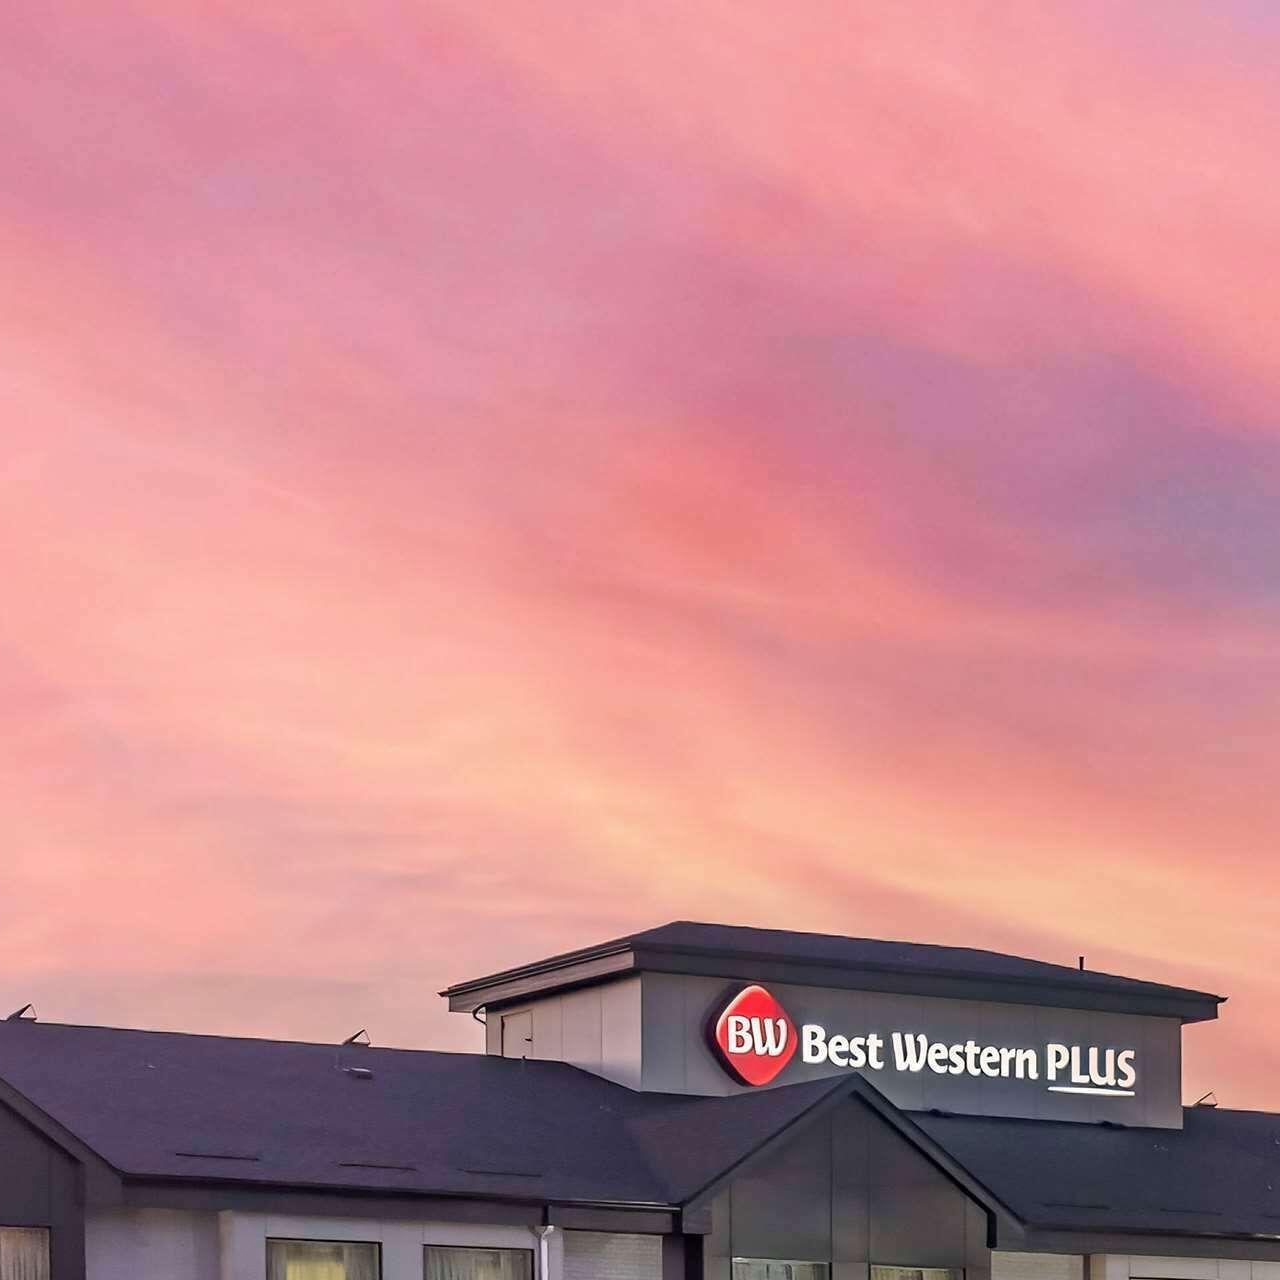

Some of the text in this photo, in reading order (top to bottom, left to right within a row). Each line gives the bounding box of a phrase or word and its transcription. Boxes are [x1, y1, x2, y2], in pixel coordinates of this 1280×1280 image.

[728, 1016, 787, 1056] BW
[802, 1024, 1136, 1088] Best Western PLUS
